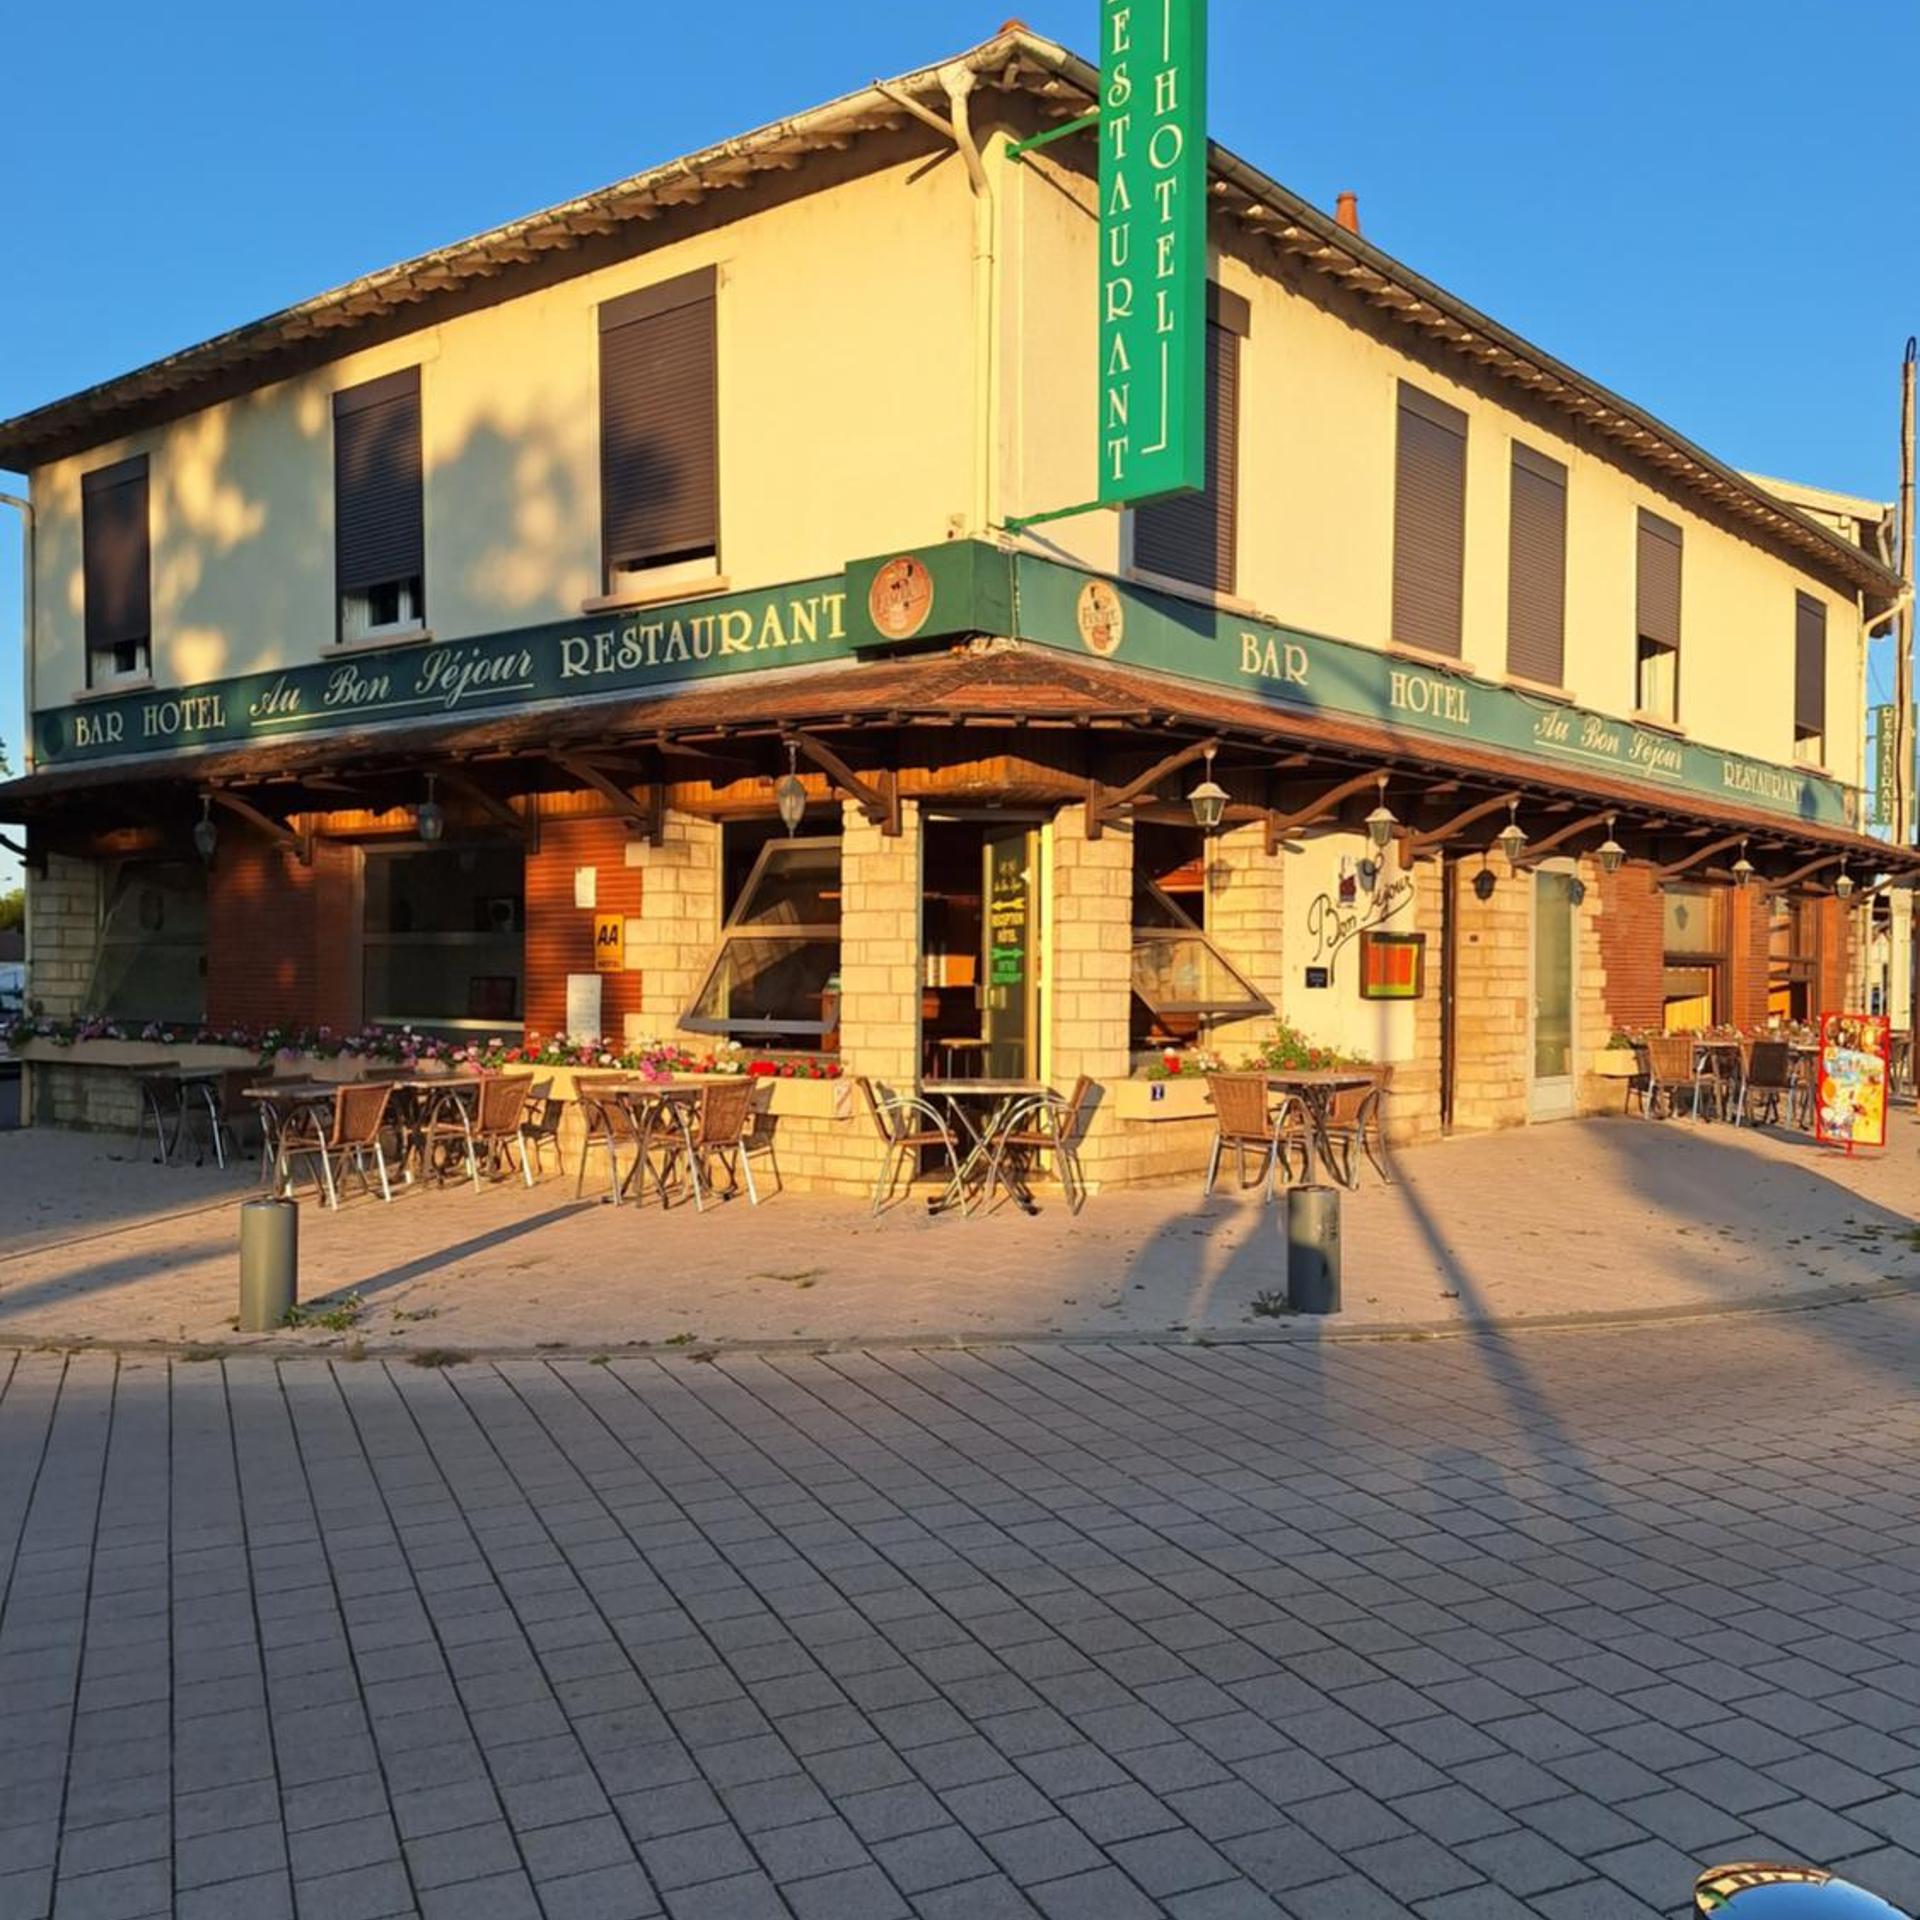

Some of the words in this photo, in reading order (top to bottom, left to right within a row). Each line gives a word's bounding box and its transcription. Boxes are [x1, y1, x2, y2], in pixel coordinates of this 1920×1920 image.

[1105, 0, 1133, 481] ESTAURANT
[1148, 66, 1183, 334] HOTEL
[75, 711, 123, 747] BAR
[142, 694, 226, 738] HOTEL
[249, 676, 302, 717] Au
[323, 663, 390, 706] Bon
[414, 647, 533, 710] Séjour
[559, 592, 846, 679] RESTAURANT
[1239, 632, 1309, 686] BAR
[1389, 671, 1470, 724] HOTEL
[1533, 709, 1570, 742] Au
[1581, 714, 1619, 754] Bon
[1722, 759, 1804, 804] RESTAURANT
[597, 924, 619, 946] AA
